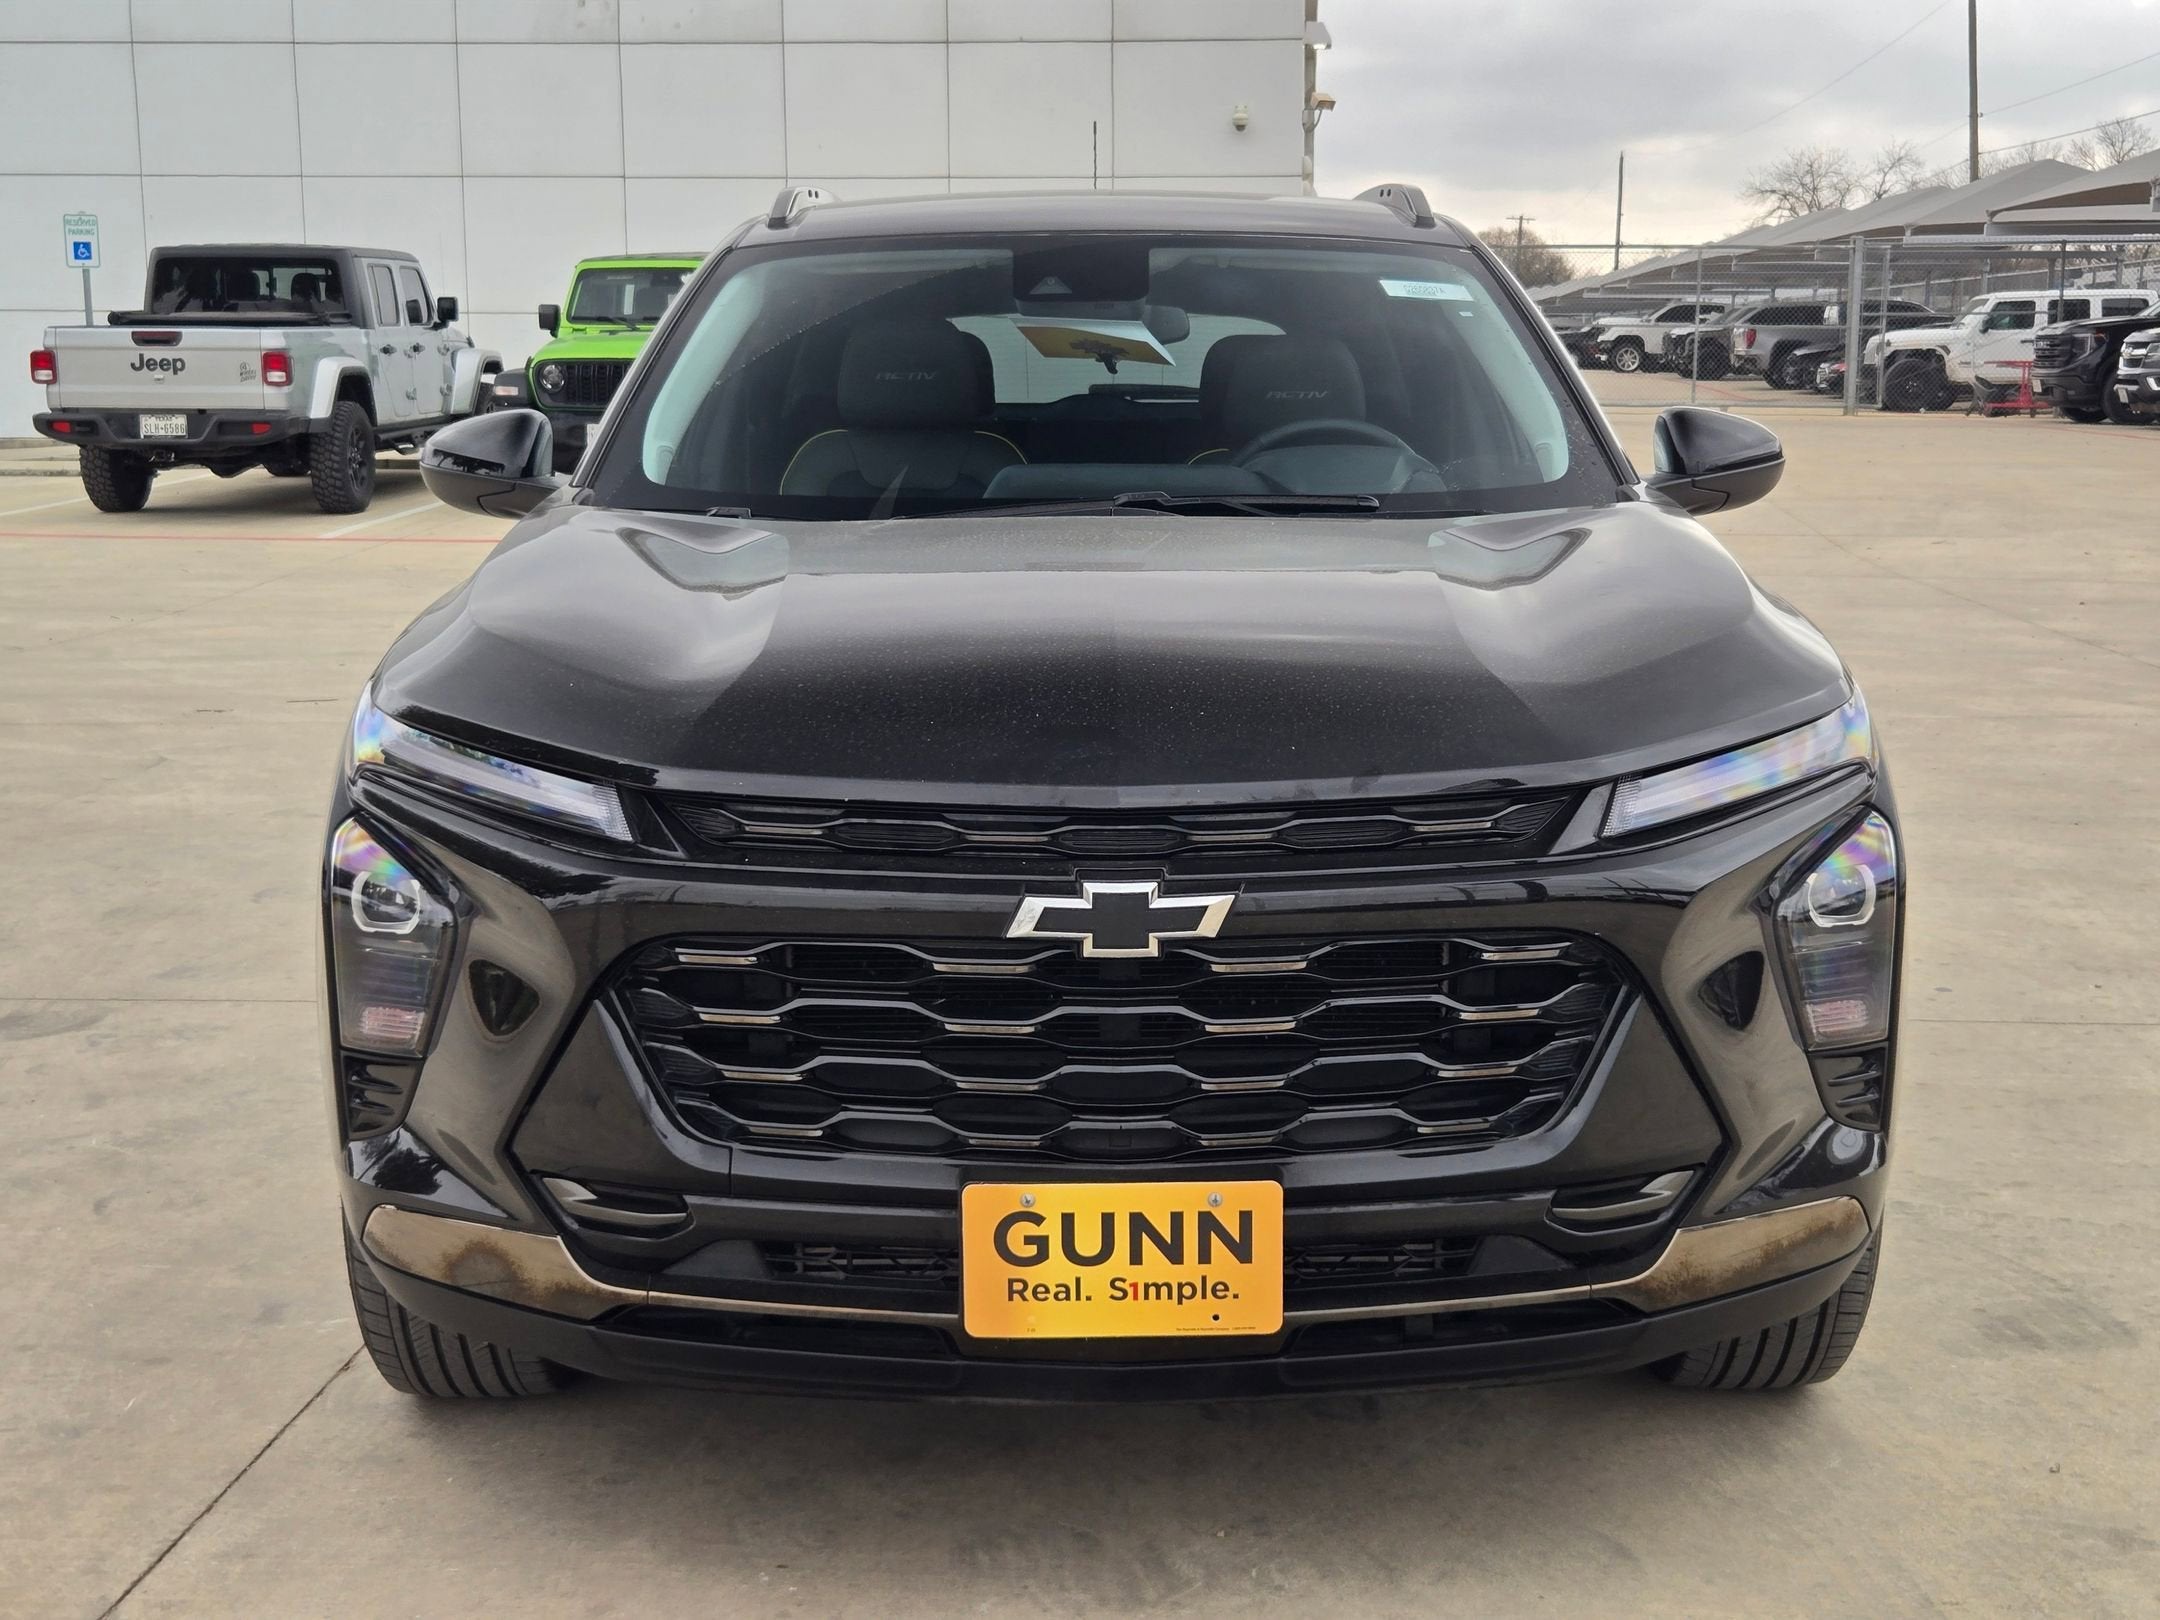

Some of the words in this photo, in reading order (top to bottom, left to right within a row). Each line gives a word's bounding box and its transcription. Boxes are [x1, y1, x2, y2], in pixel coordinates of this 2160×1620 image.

[65, 218, 96, 226] RESERVED
[130, 353, 186, 375] Jeep
[875, 371, 938, 381] ACTIV
[1266, 390, 1329, 400] ACTIV
[993, 1210, 1253, 1267] GUNN
[1007, 1276, 1092, 1302] Real.
[1109, 1275, 1240, 1305] S1mple.
